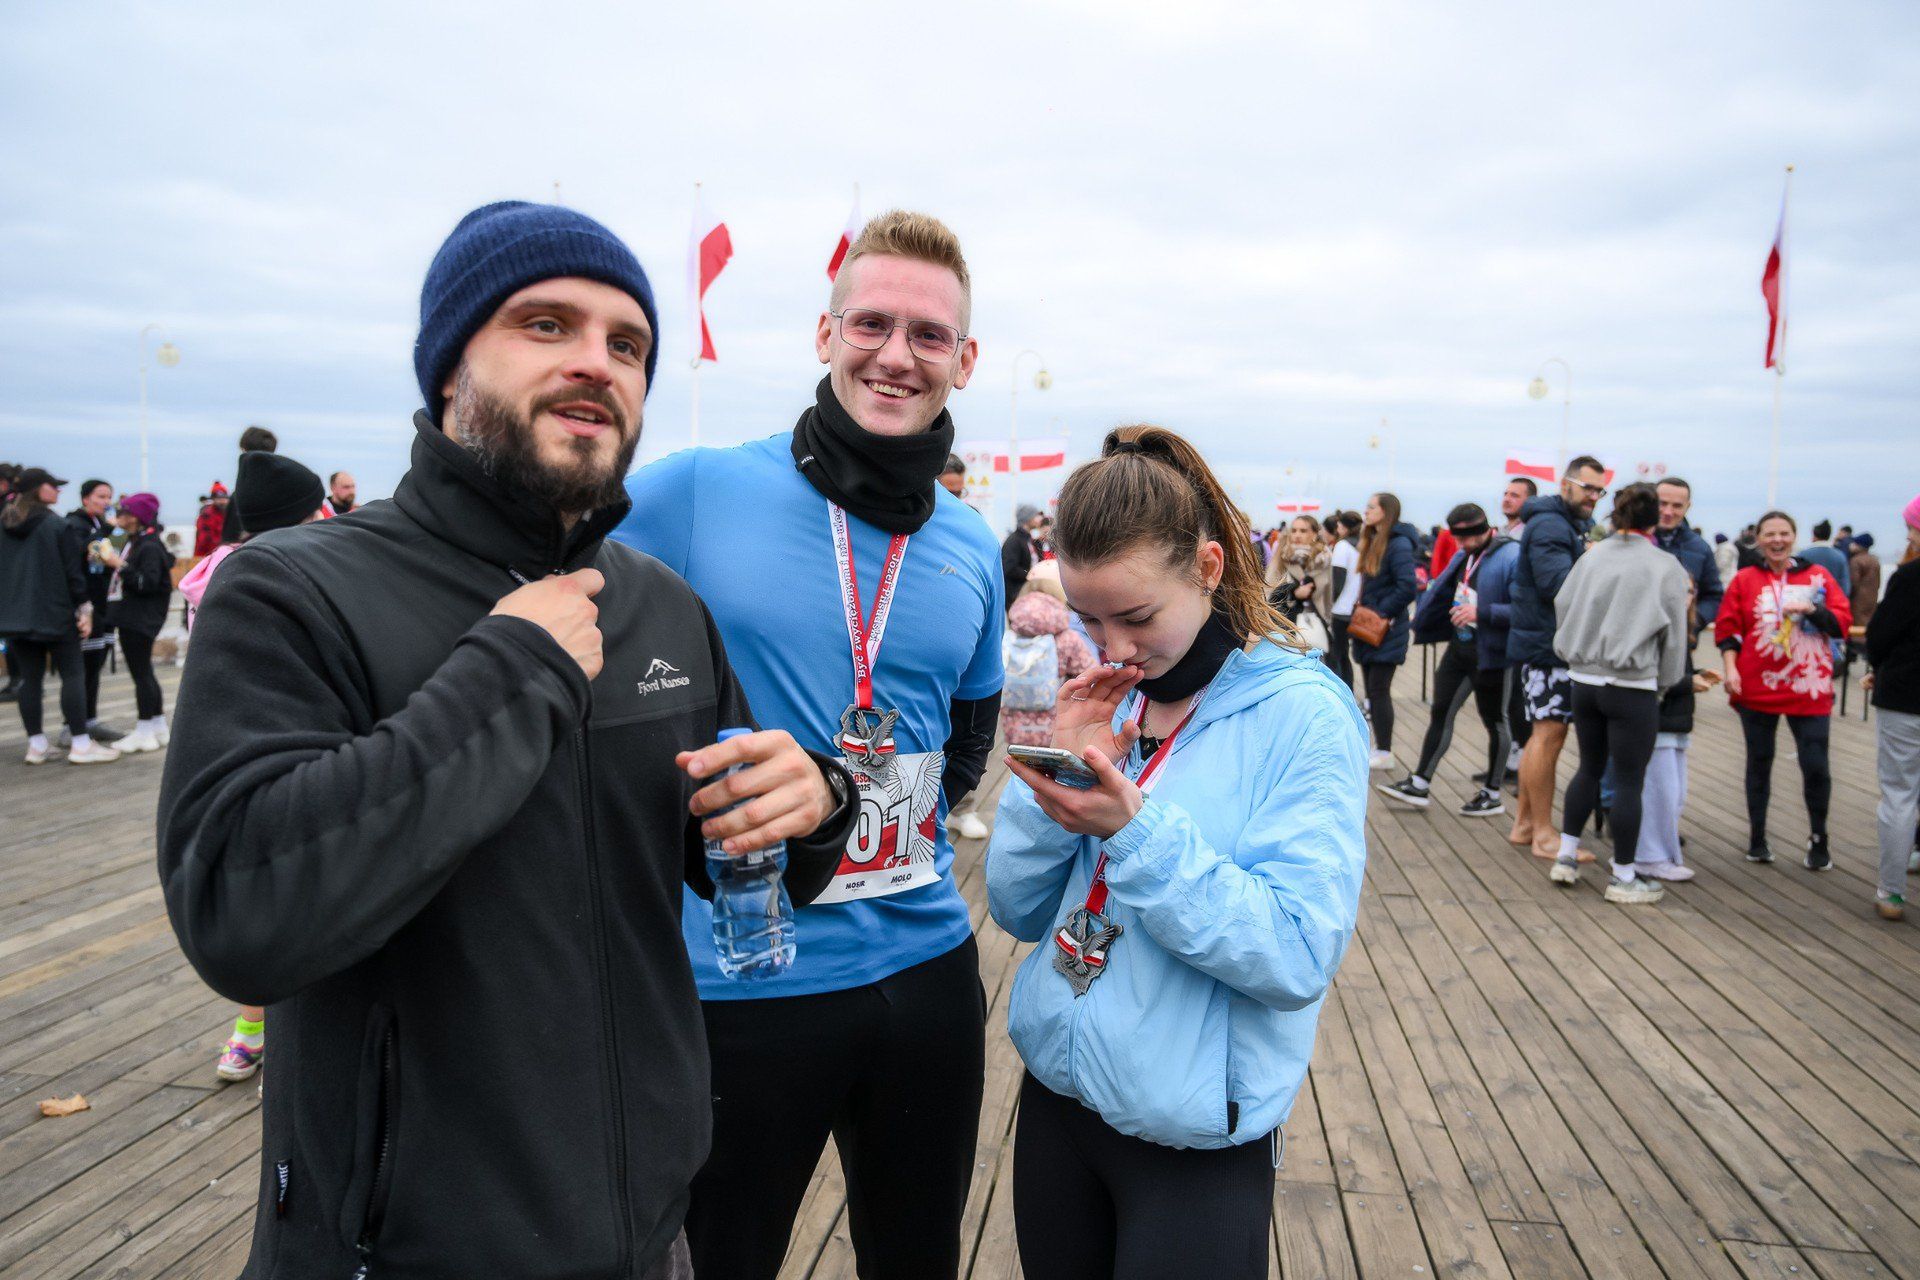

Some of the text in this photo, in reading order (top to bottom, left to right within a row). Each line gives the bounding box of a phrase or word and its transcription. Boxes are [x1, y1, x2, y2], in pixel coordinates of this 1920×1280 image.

[637, 676, 690, 697] Fjord Nansen
[890, 873, 912, 884] MOLO
